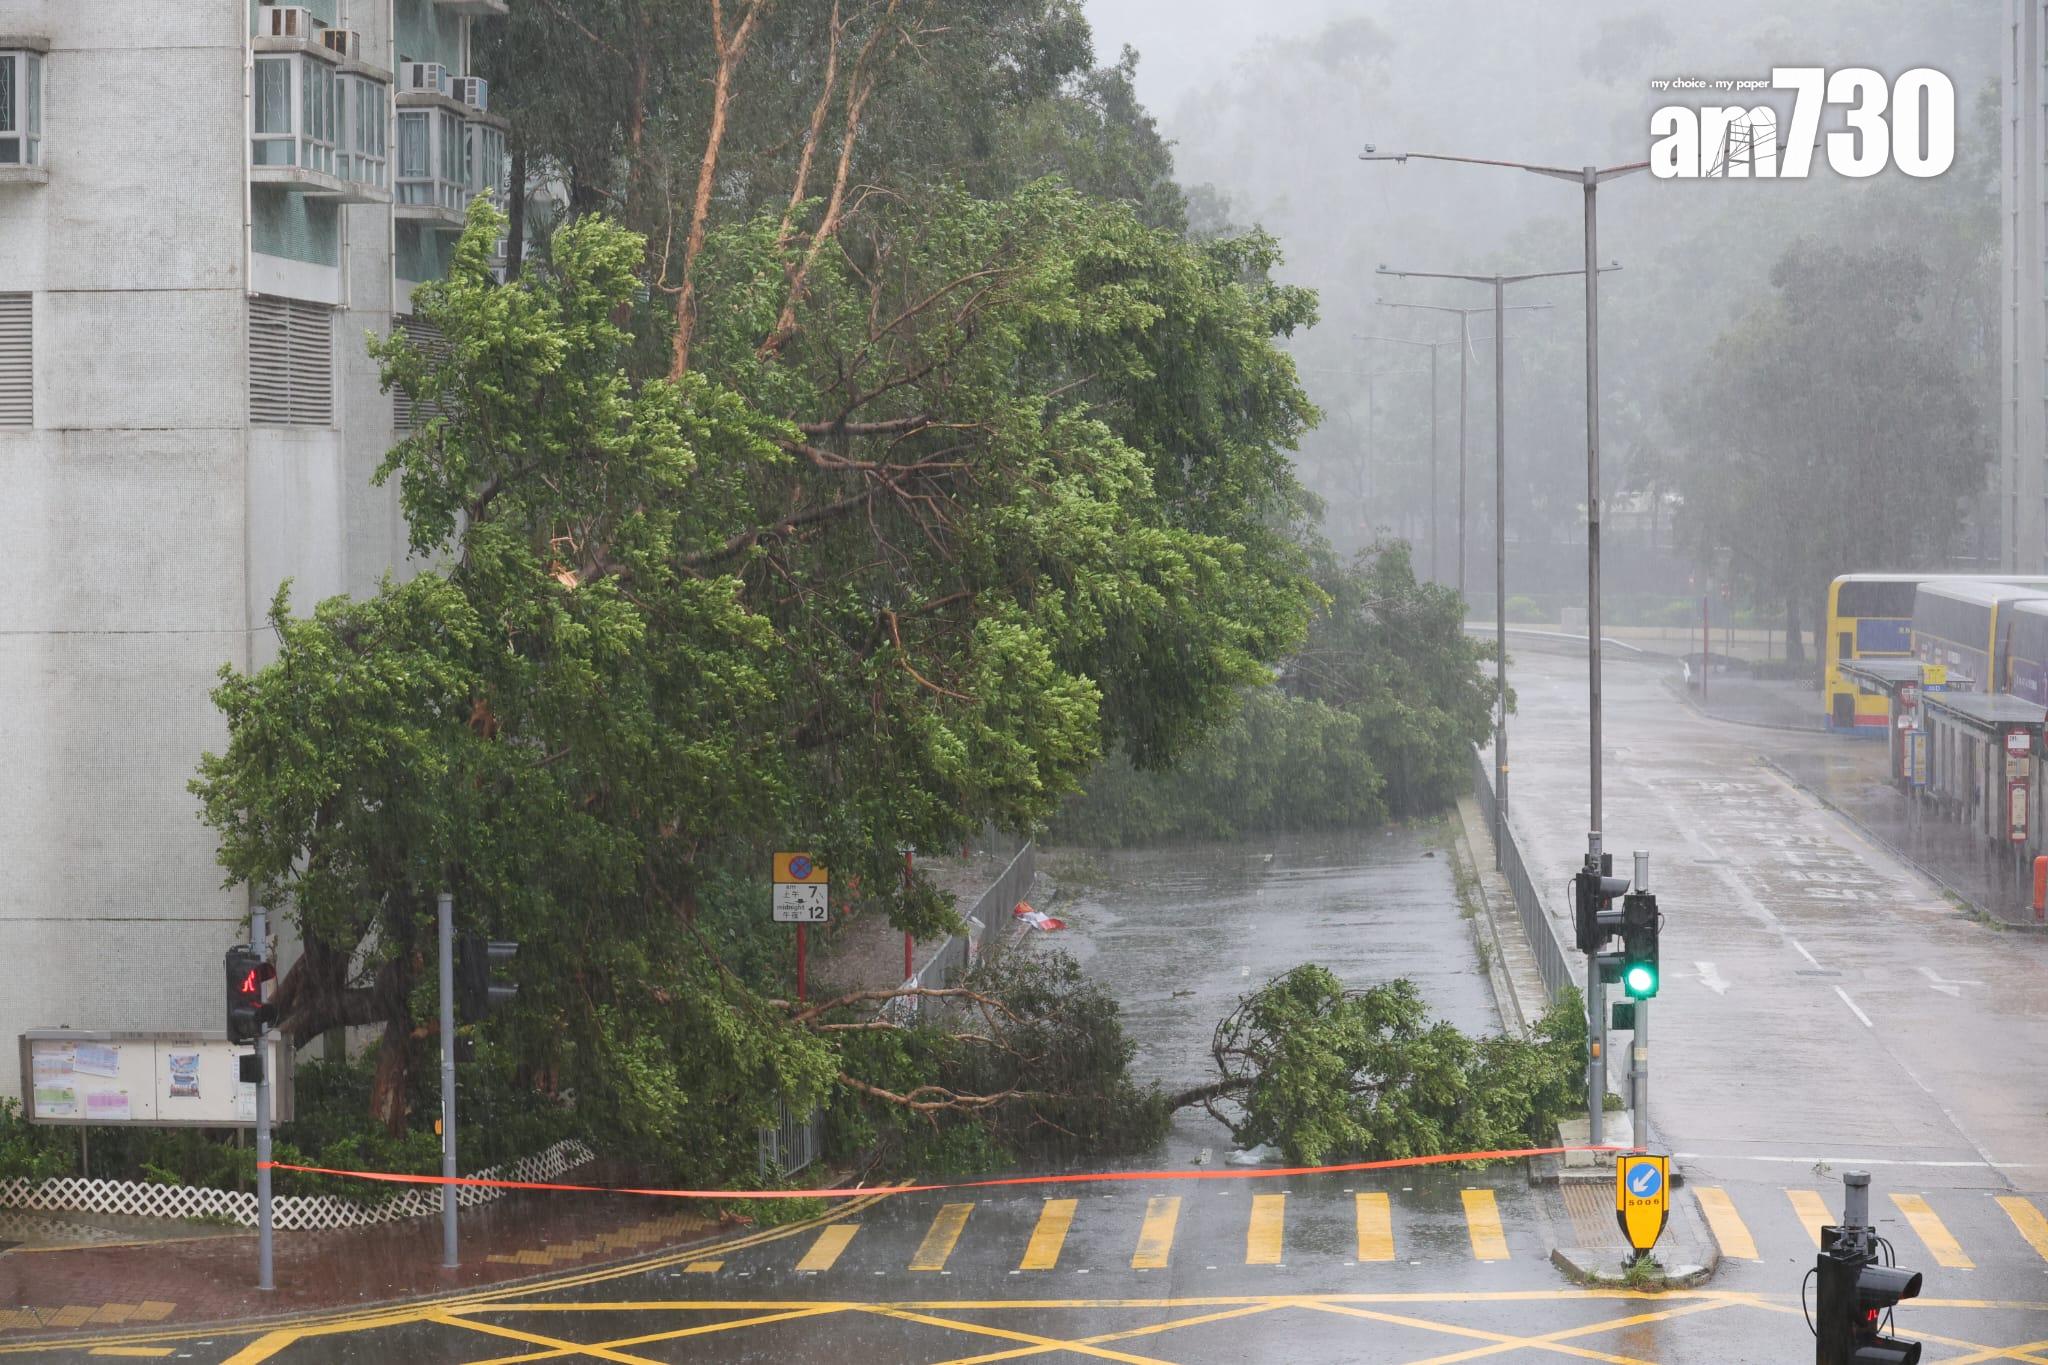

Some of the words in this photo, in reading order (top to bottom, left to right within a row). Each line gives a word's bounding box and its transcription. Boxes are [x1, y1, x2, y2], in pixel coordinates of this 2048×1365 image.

[809, 886, 818, 898] 7
[777, 903, 805, 911] midnight
[808, 906, 824, 919] 12
